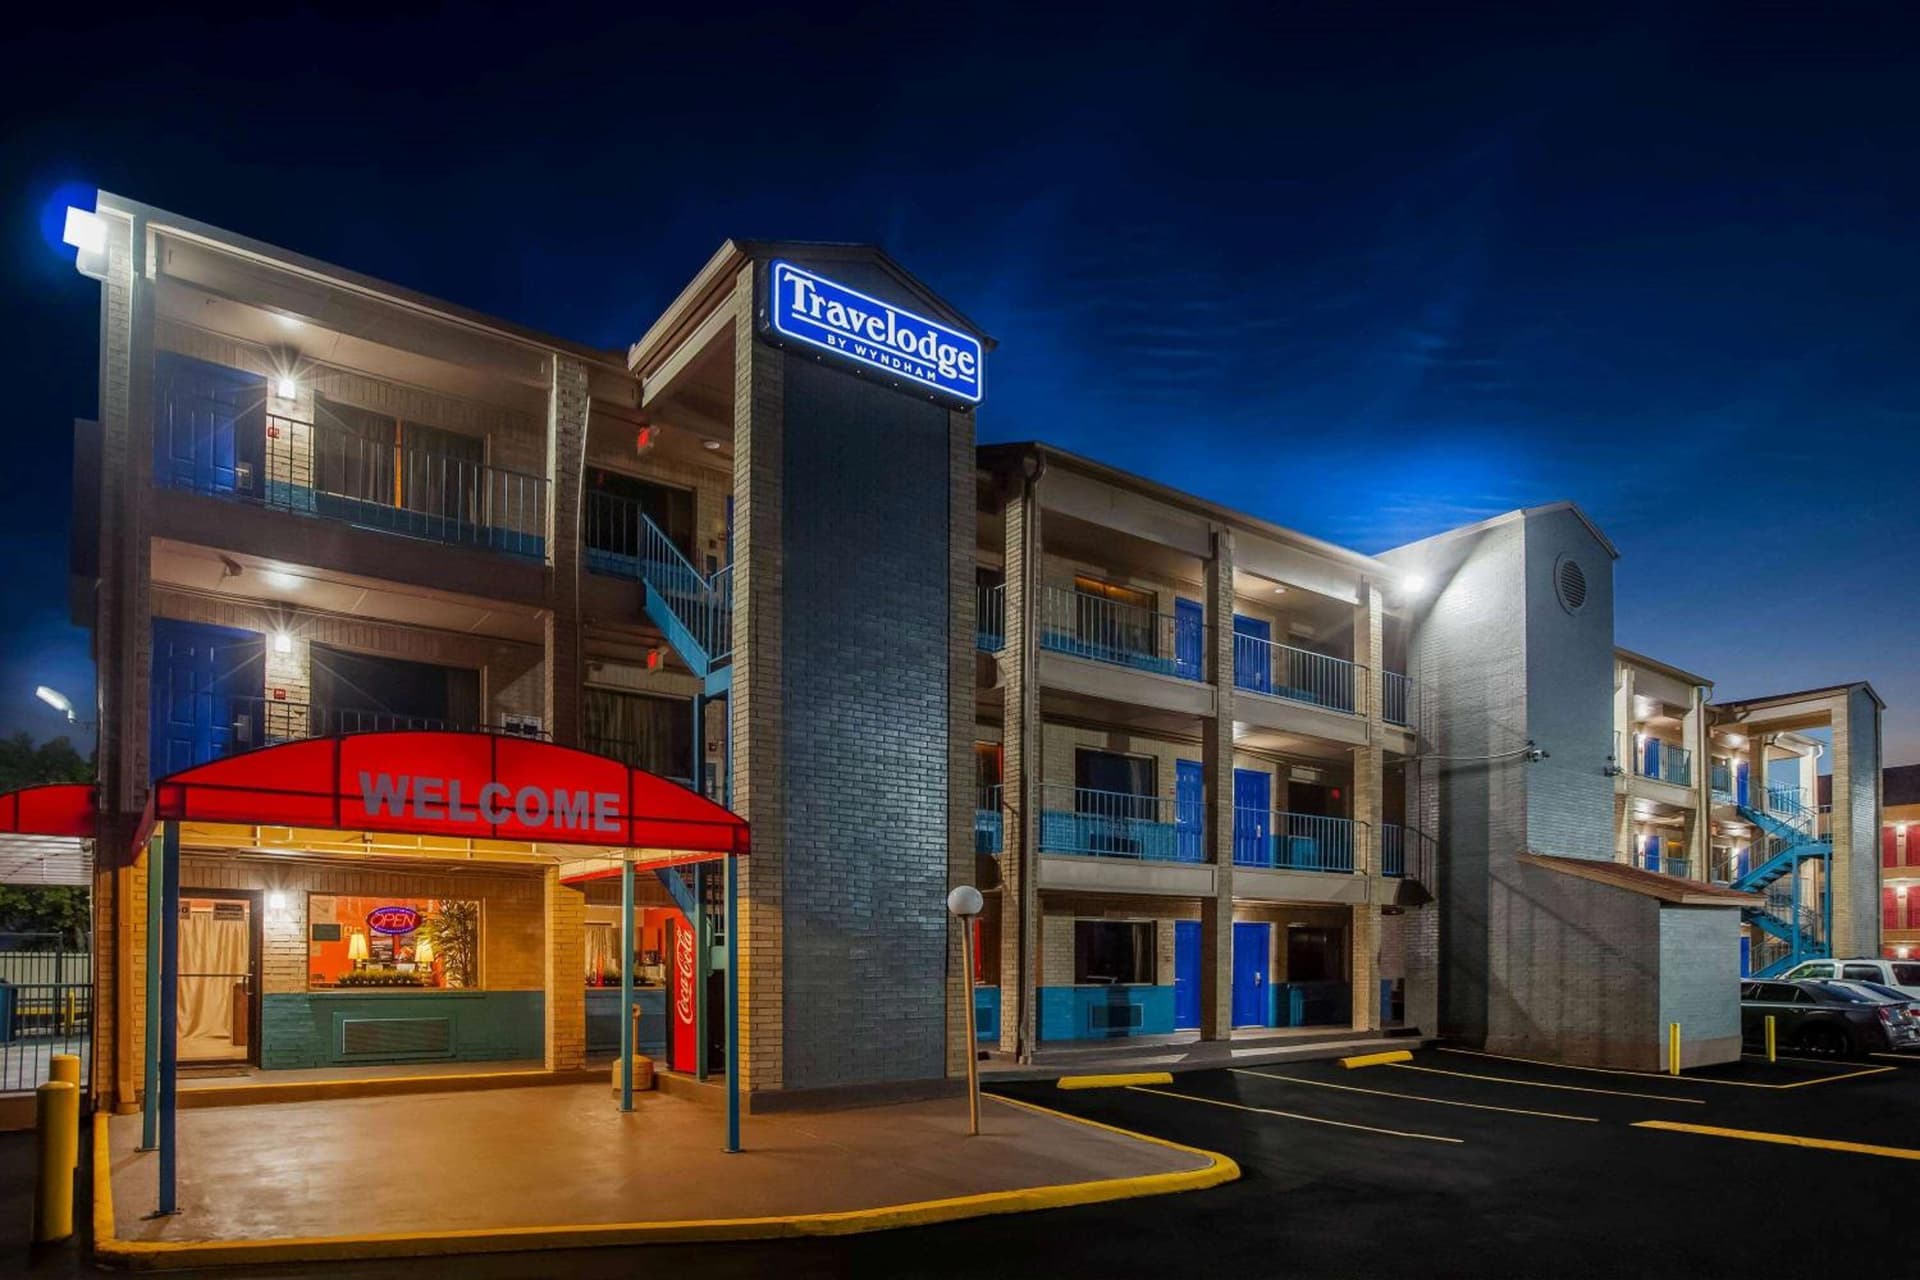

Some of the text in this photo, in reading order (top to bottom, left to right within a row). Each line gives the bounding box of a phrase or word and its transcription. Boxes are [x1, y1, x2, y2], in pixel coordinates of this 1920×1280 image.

[784, 271, 975, 379] Travelodge
[827, 334, 936, 382] BY WYNDHAM
[359, 771, 621, 832] WELCOME
[370, 913, 416, 928] OPEN
